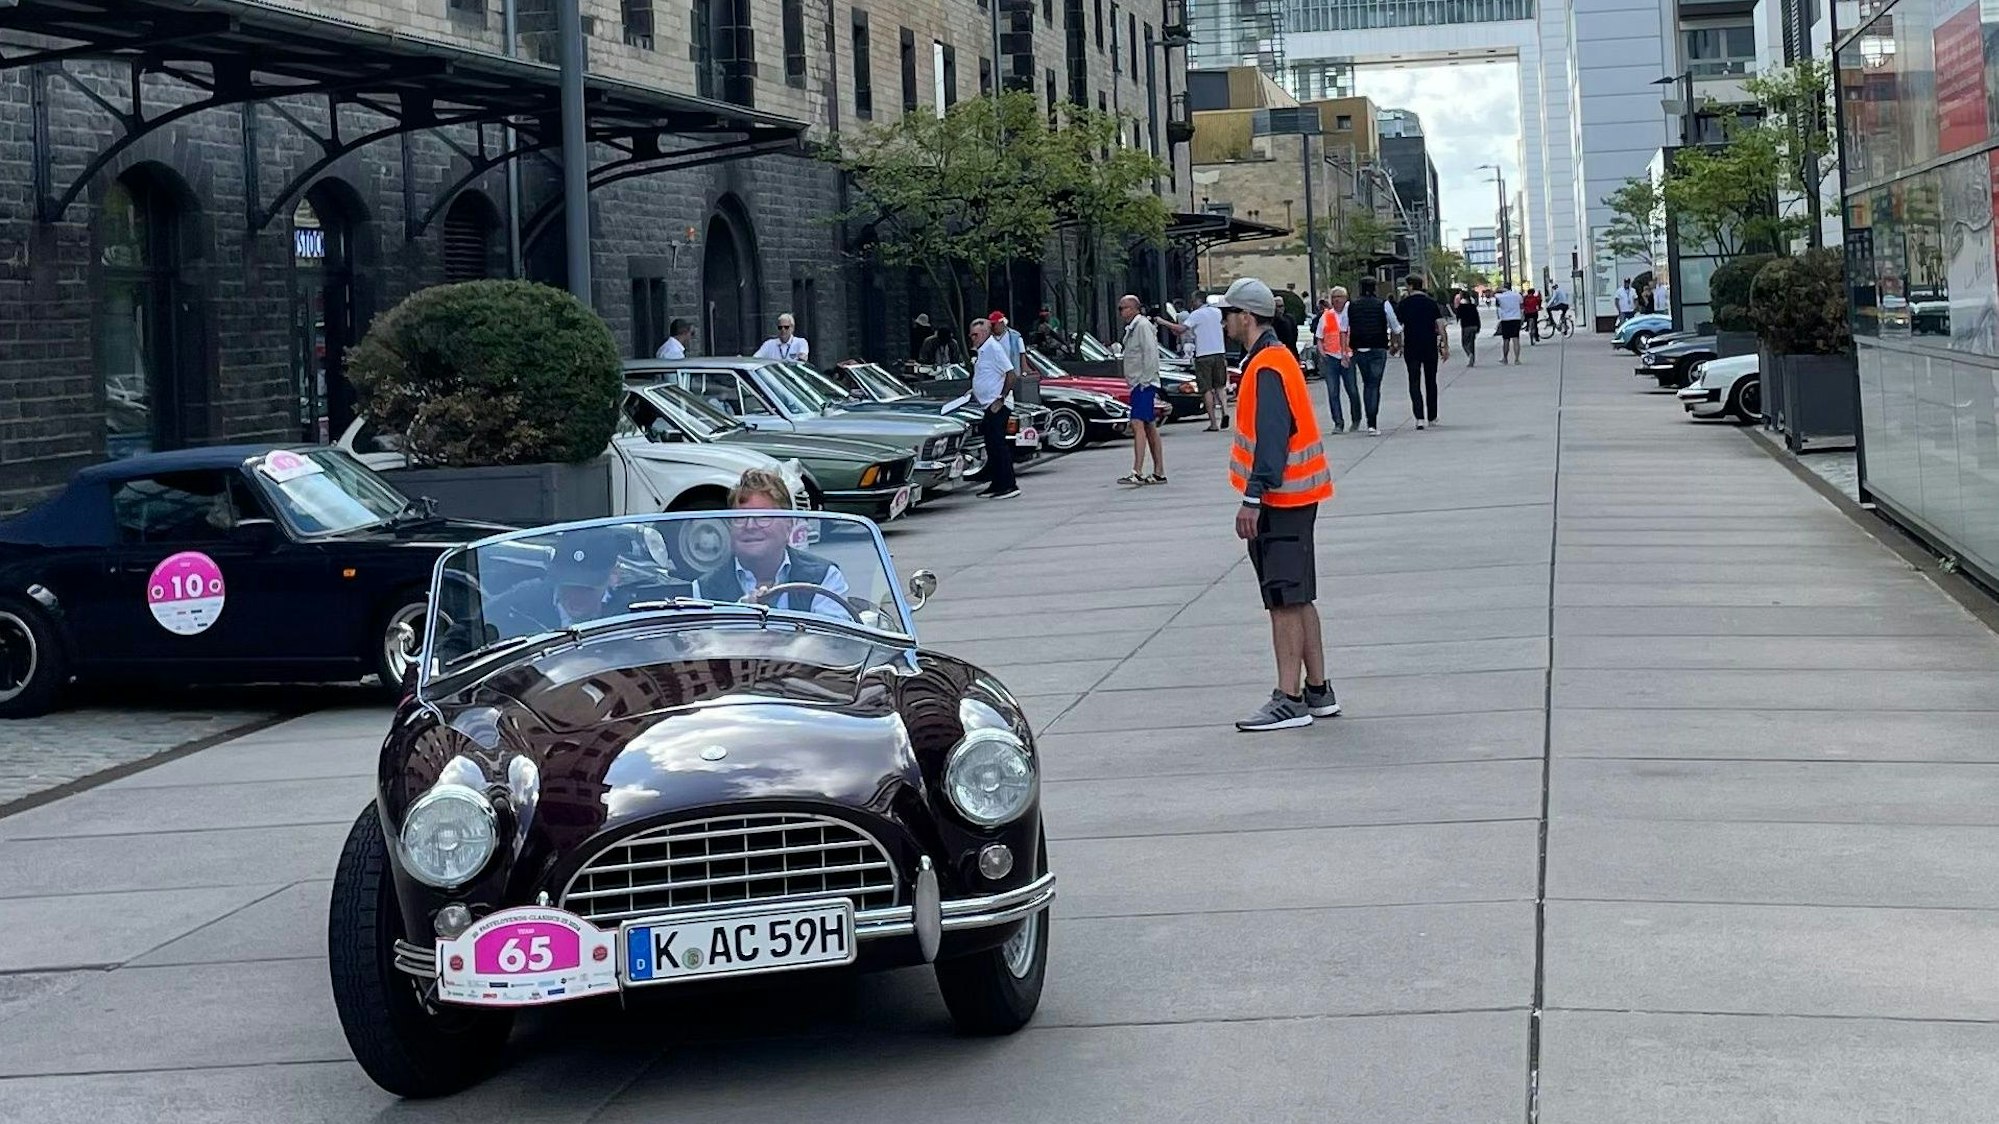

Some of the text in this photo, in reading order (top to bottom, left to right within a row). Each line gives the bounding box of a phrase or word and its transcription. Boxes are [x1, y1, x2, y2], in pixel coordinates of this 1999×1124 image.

[171, 573, 204, 598] 10
[498, 936, 554, 973] 65
[655, 914, 844, 970] K AC 59H
[636, 958, 646, 971] D
